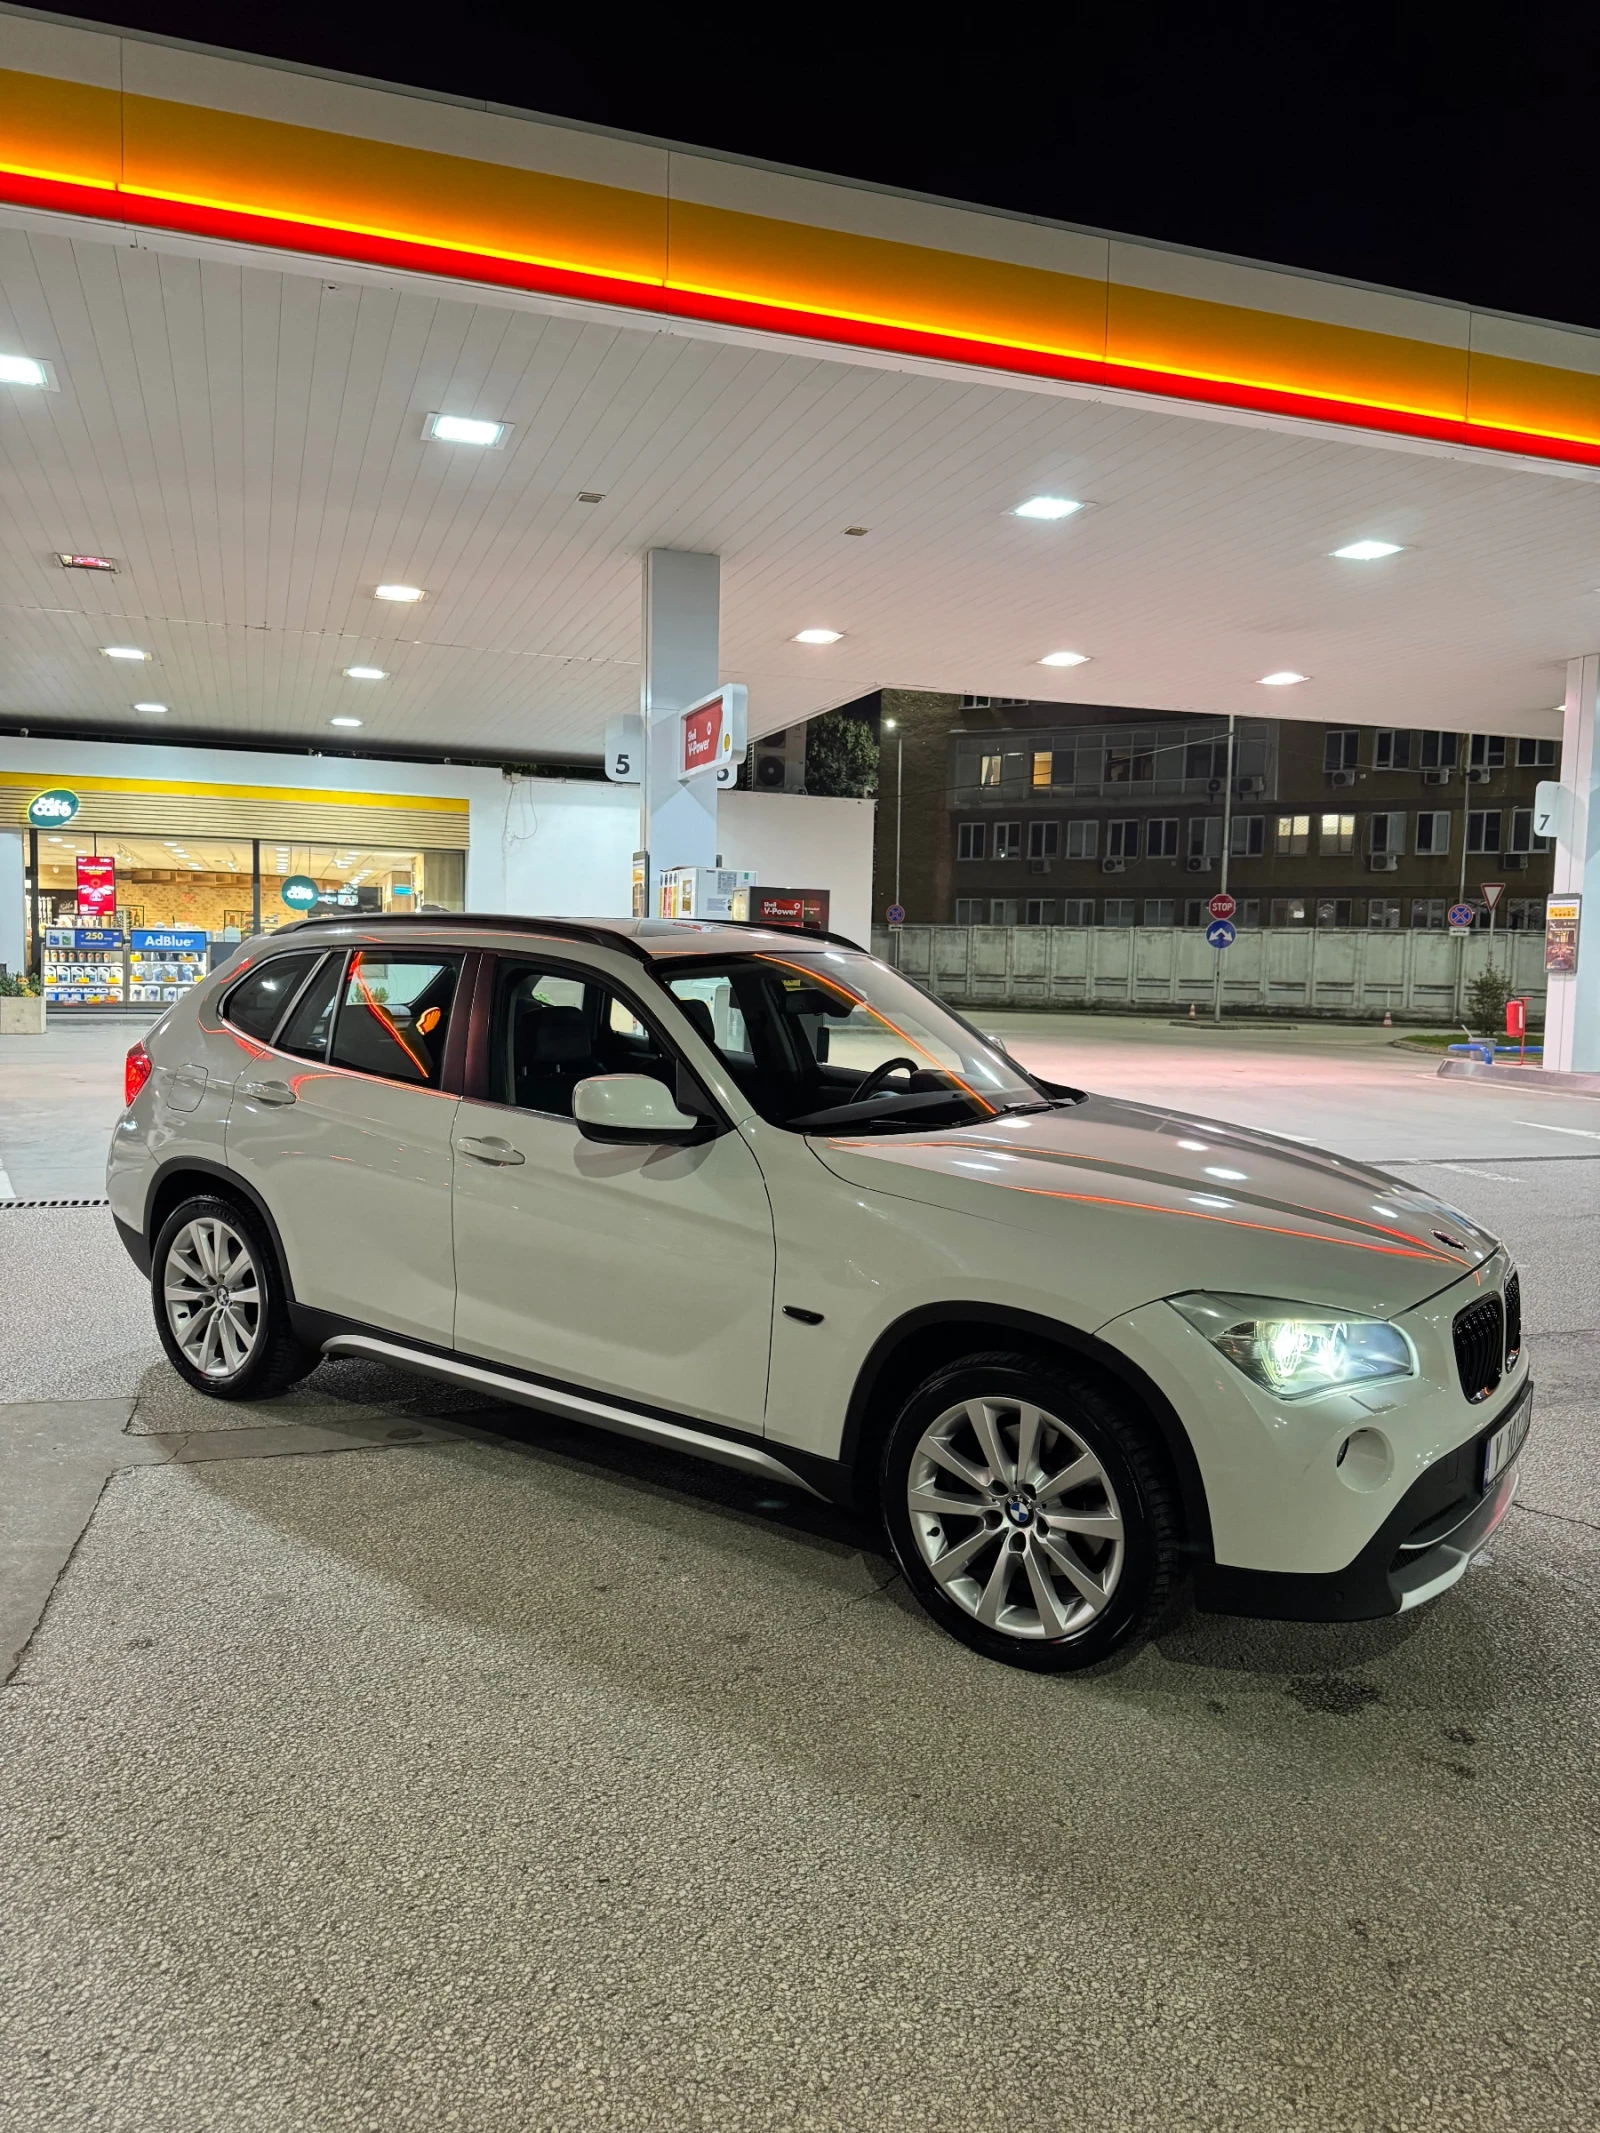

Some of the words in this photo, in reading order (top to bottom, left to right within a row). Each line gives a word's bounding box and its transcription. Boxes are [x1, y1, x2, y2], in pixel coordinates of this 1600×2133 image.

[687, 728, 697, 742] Shell
[687, 739, 710, 757] V-Power
[615, 754, 631, 775] 5
[1538, 814, 1551, 831] 7
[763, 907, 798, 916] V-Power
[1212, 902, 1233, 912] STOP
